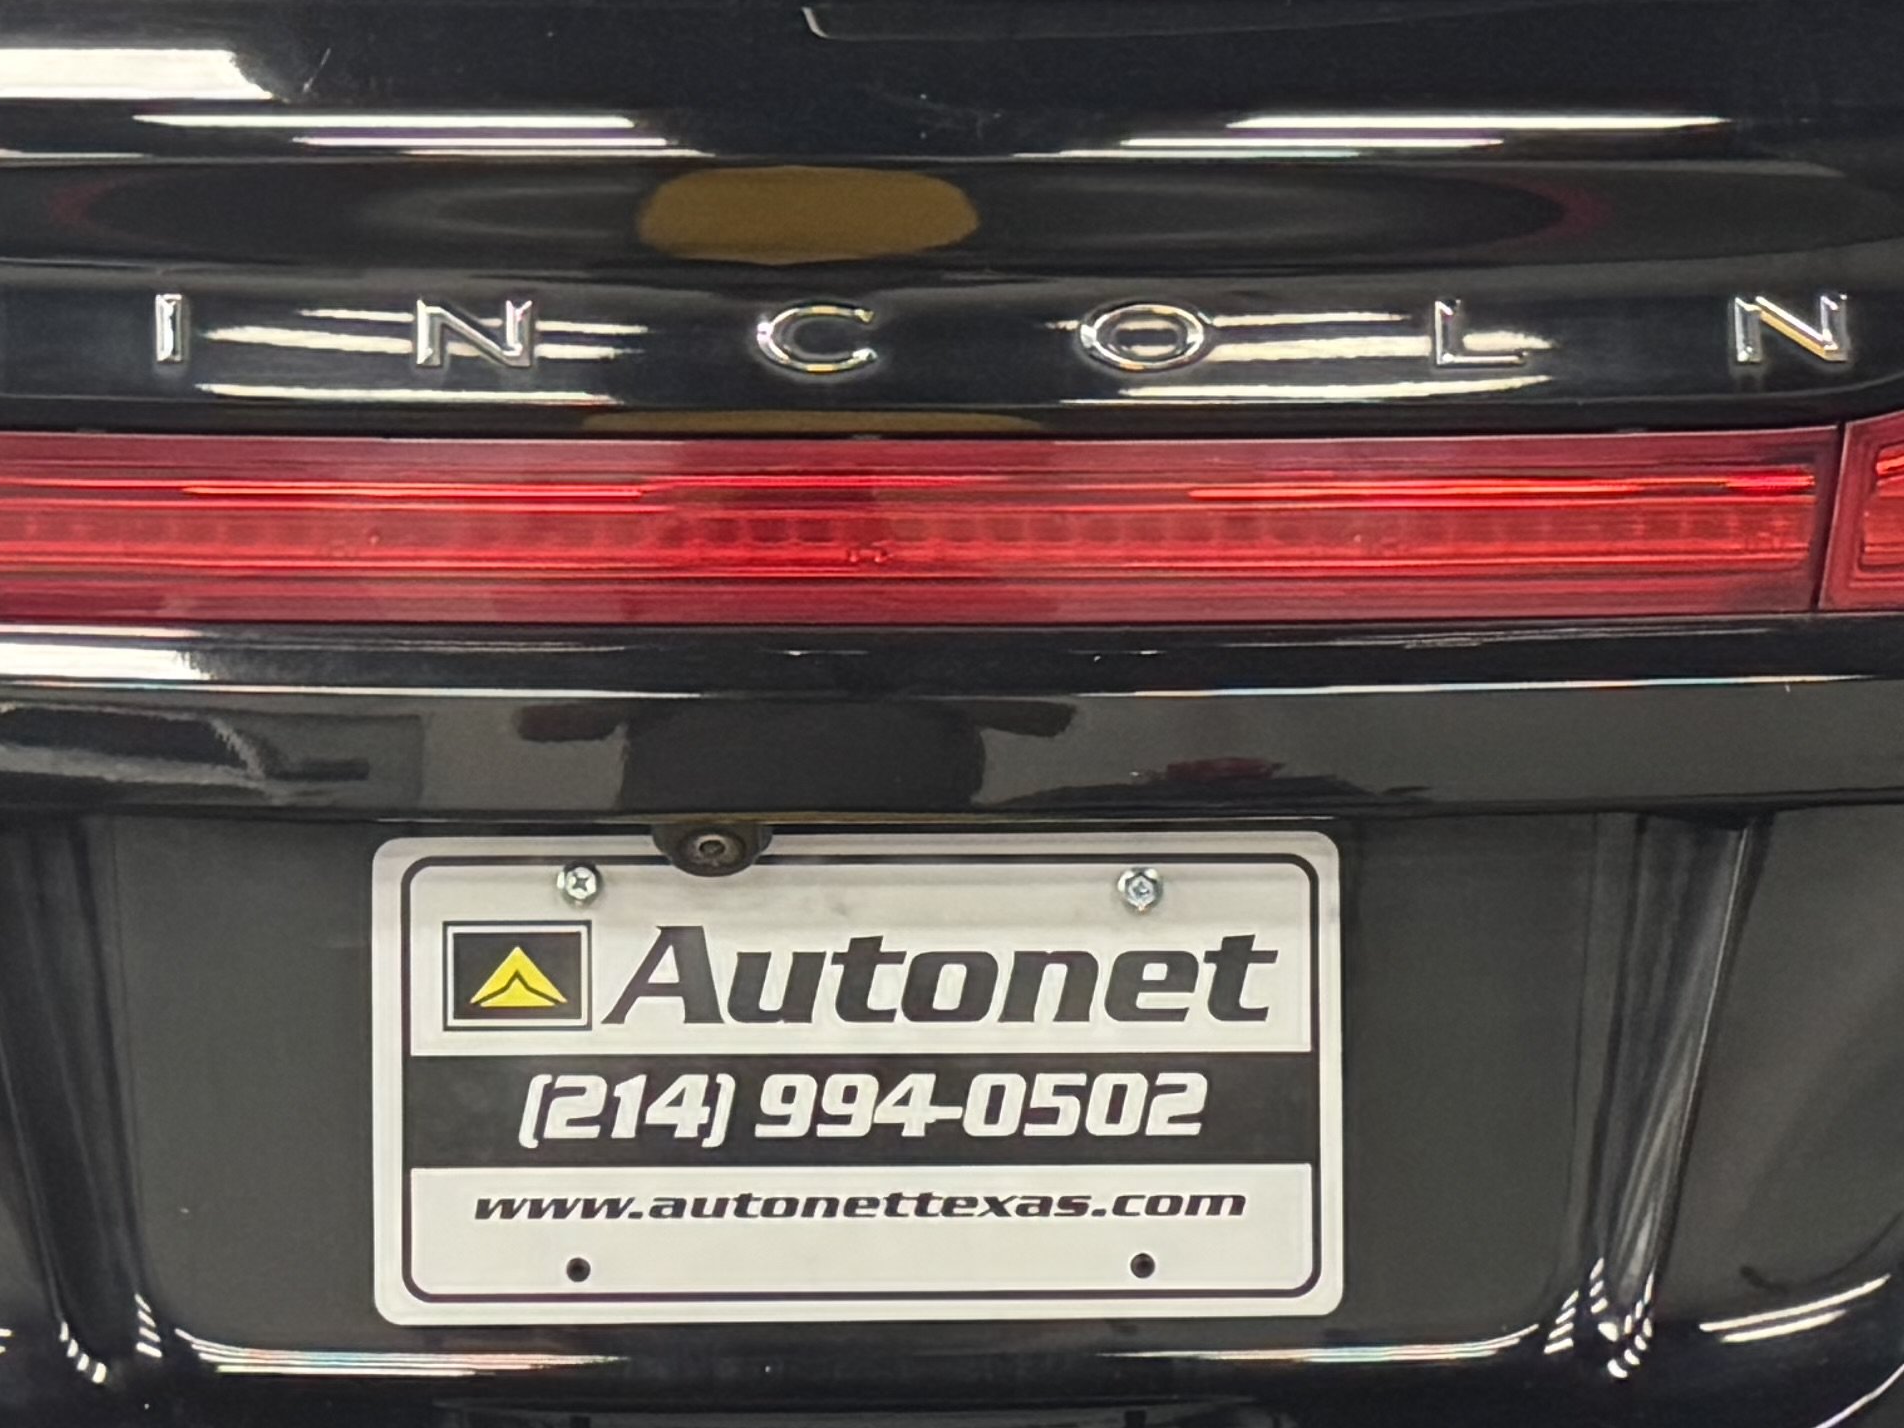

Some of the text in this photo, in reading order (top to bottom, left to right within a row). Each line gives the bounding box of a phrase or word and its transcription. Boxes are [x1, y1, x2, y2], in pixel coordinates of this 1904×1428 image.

[603, 924, 1280, 1024] Autonet
[518, 1072, 1209, 1149] (214) 994-0502
[474, 1189, 1248, 1221] www.autonettexas.com
